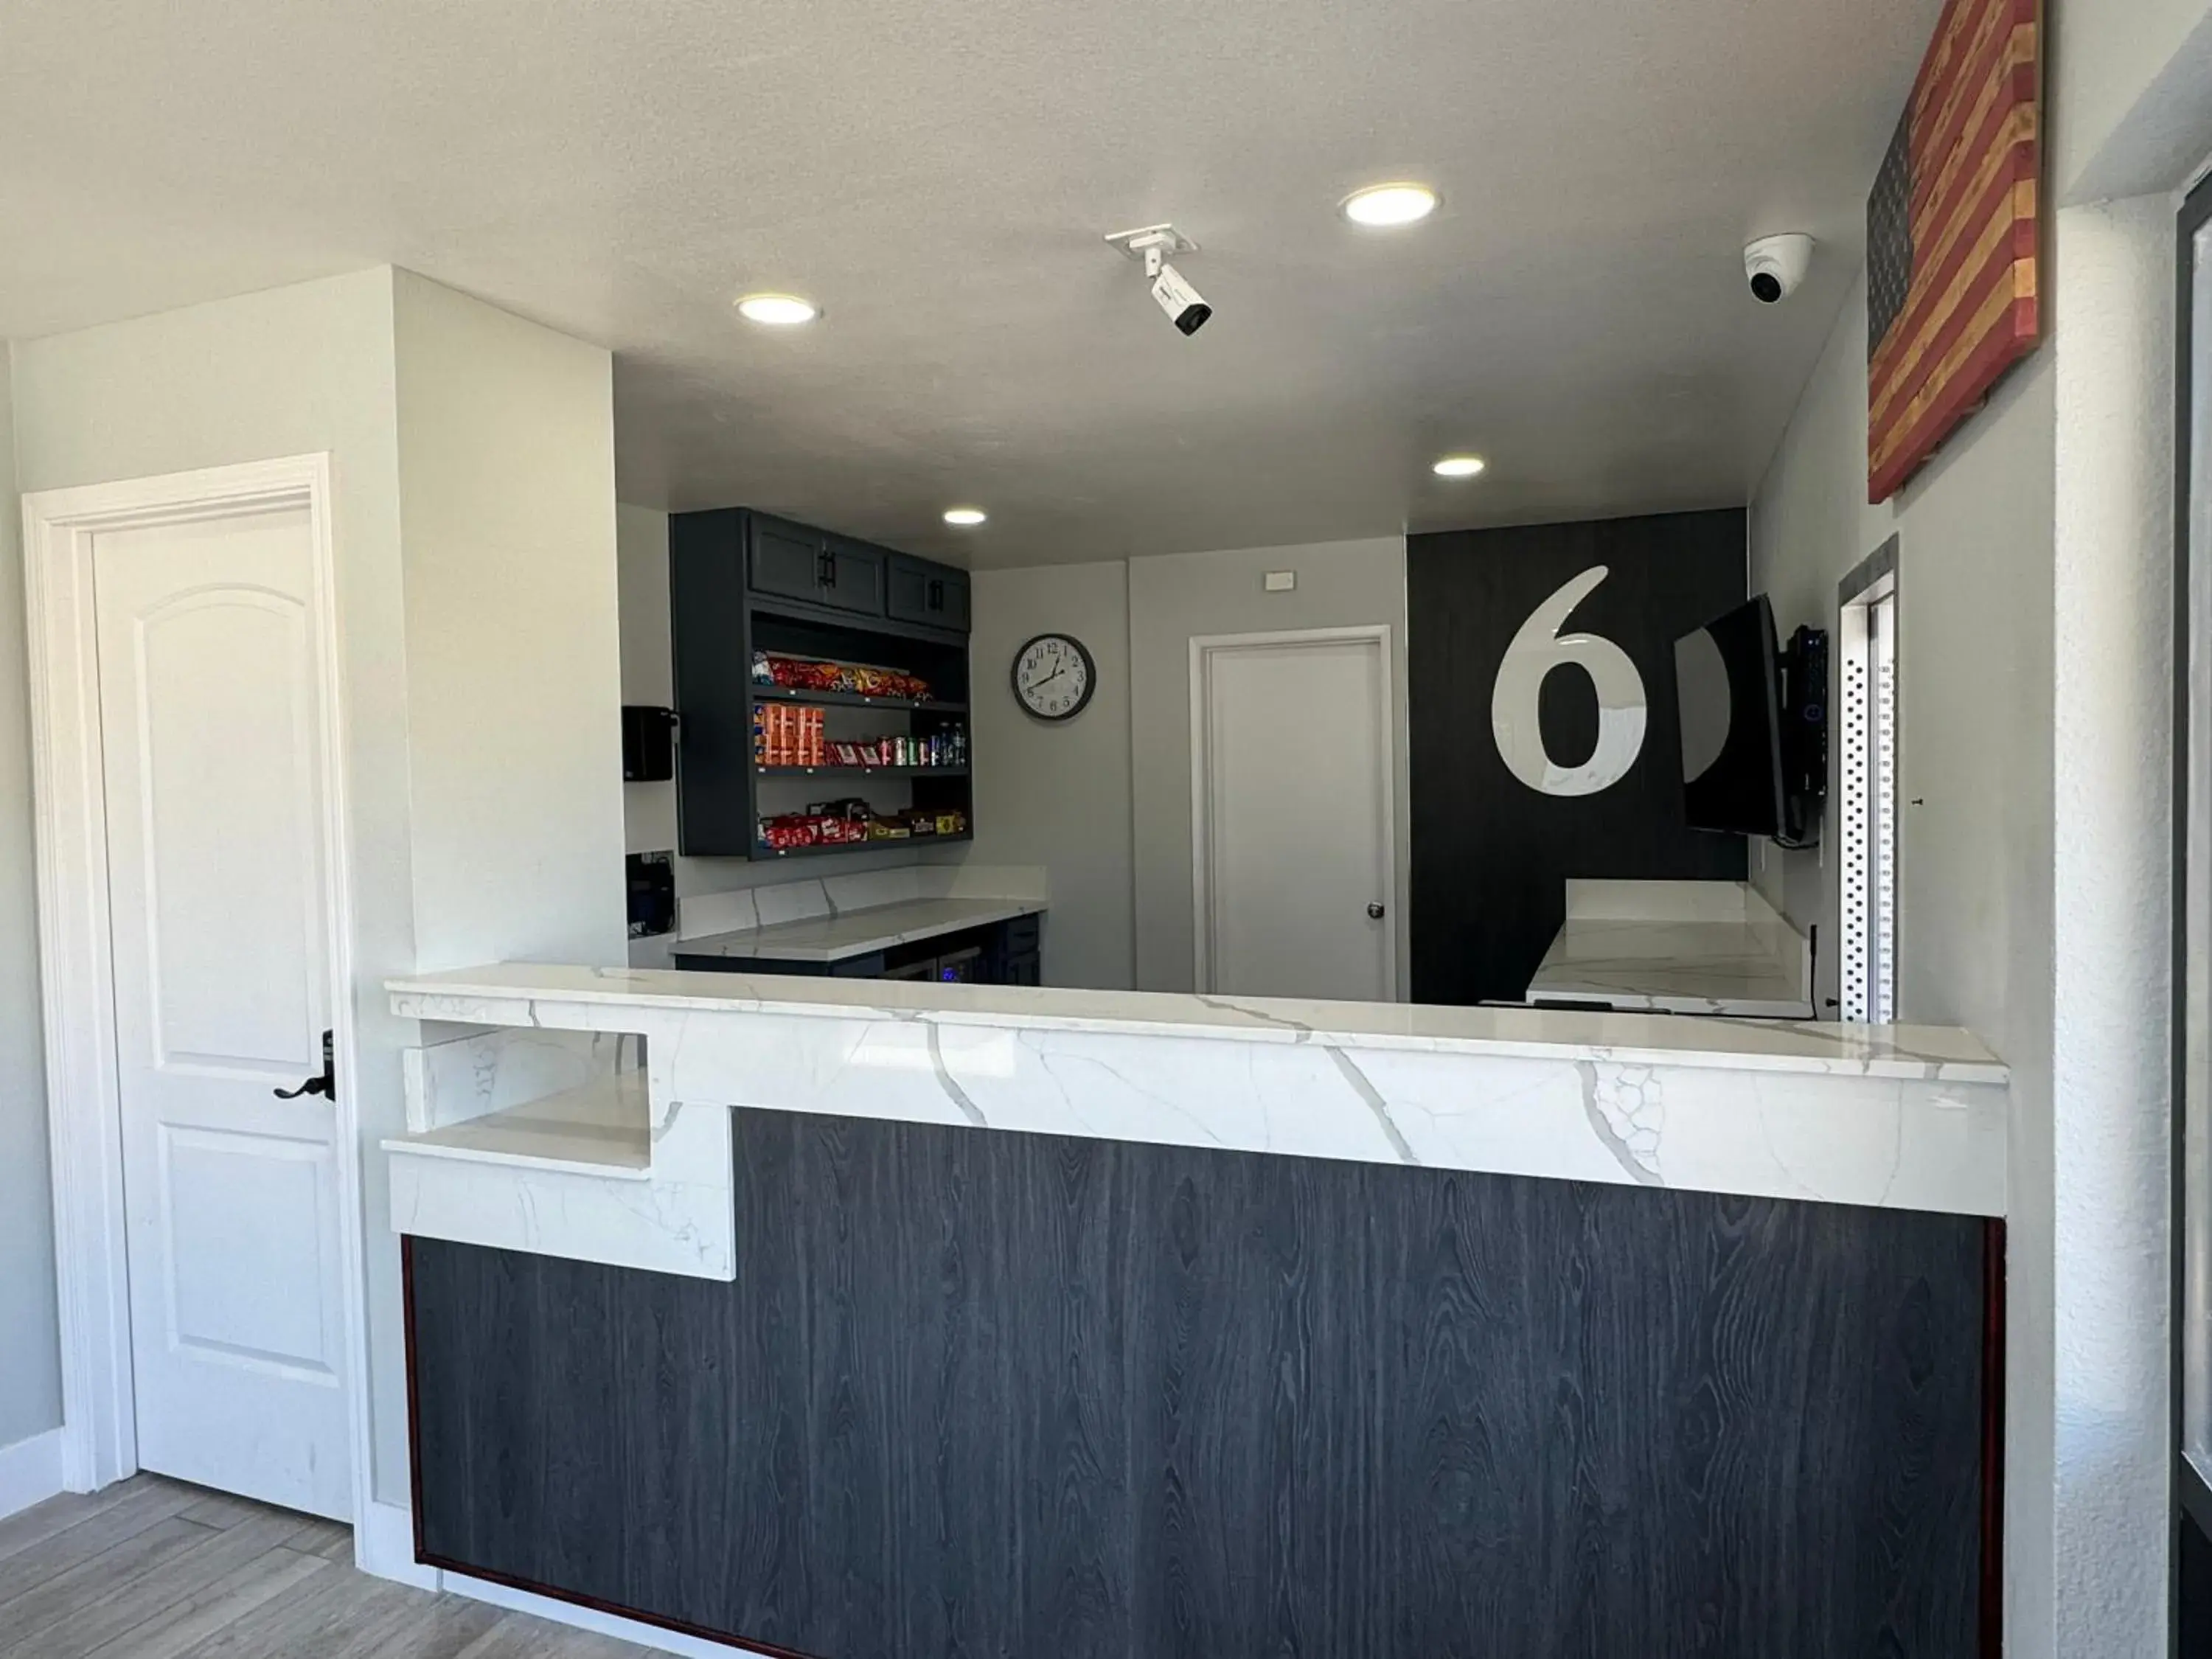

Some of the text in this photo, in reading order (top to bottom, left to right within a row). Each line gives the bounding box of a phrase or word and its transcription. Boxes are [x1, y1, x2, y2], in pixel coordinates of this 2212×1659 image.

[1036, 648, 1043, 659] 11
[1048, 643, 1059, 655] 12
[1064, 644, 1068, 658] 1
[1027, 658, 1037, 670] 10
[1071, 655, 1079, 667] 2
[1077, 669, 1084, 682] 3
[1492, 565, 1647, 796] 6
[1037, 695, 1043, 708] 7
[1050, 700, 1057, 712] 6
[1062, 695, 1070, 707] 5
